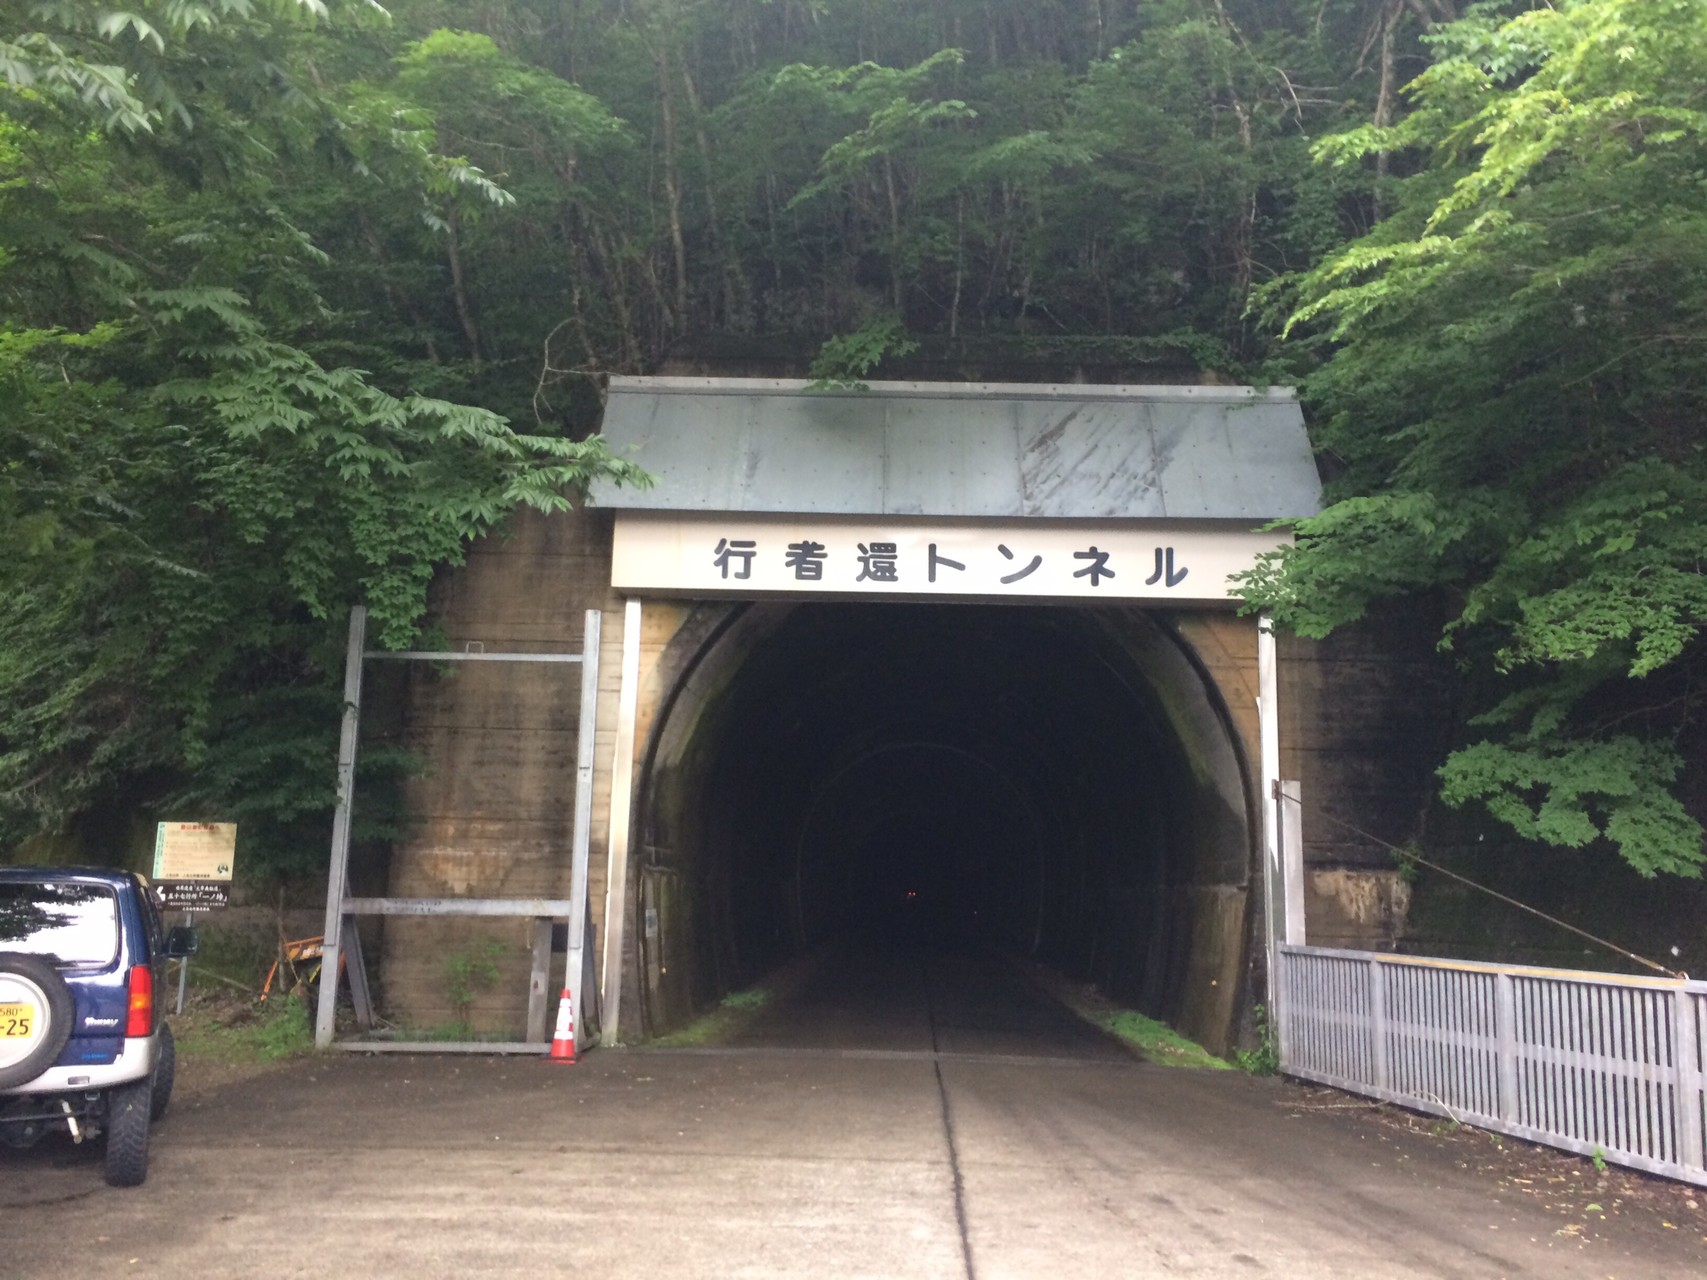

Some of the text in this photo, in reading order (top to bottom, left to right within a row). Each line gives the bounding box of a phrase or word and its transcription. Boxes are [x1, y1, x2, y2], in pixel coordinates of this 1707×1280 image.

[713, 537, 1189, 588] 行者還トンネル
